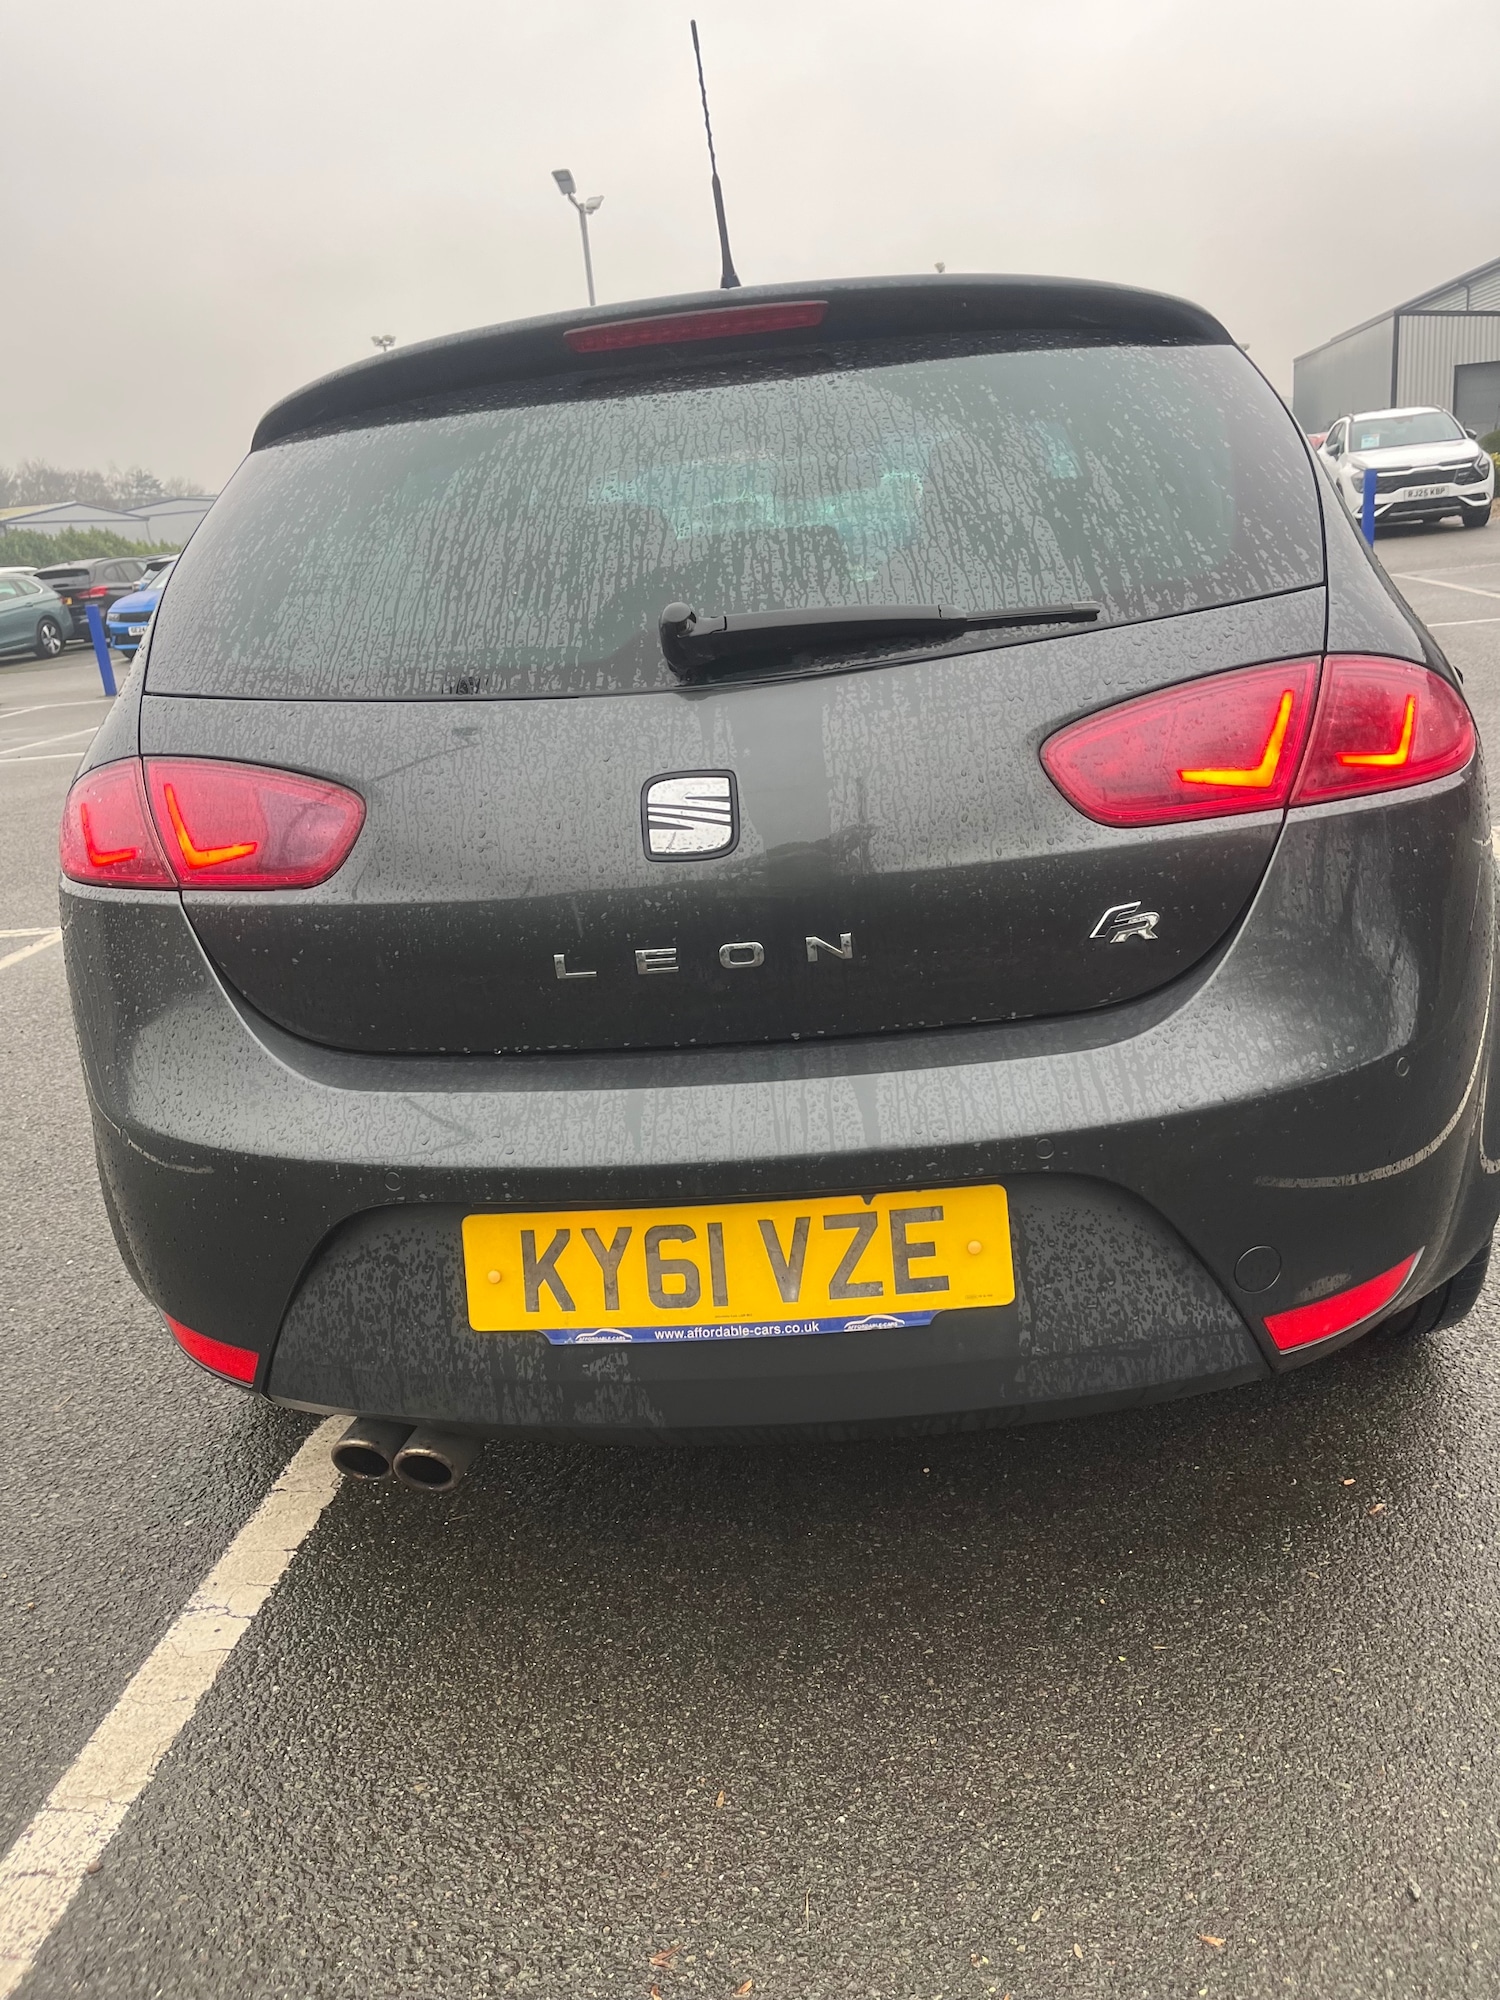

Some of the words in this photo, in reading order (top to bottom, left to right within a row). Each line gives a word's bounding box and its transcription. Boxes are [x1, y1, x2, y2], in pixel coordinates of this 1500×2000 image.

[553, 932, 853, 979] LEON
[520, 1222, 729, 1313] KY61
[758, 1205, 950, 1303] VZE
[654, 1321, 820, 1340] www.affordable-cars.co.uk
